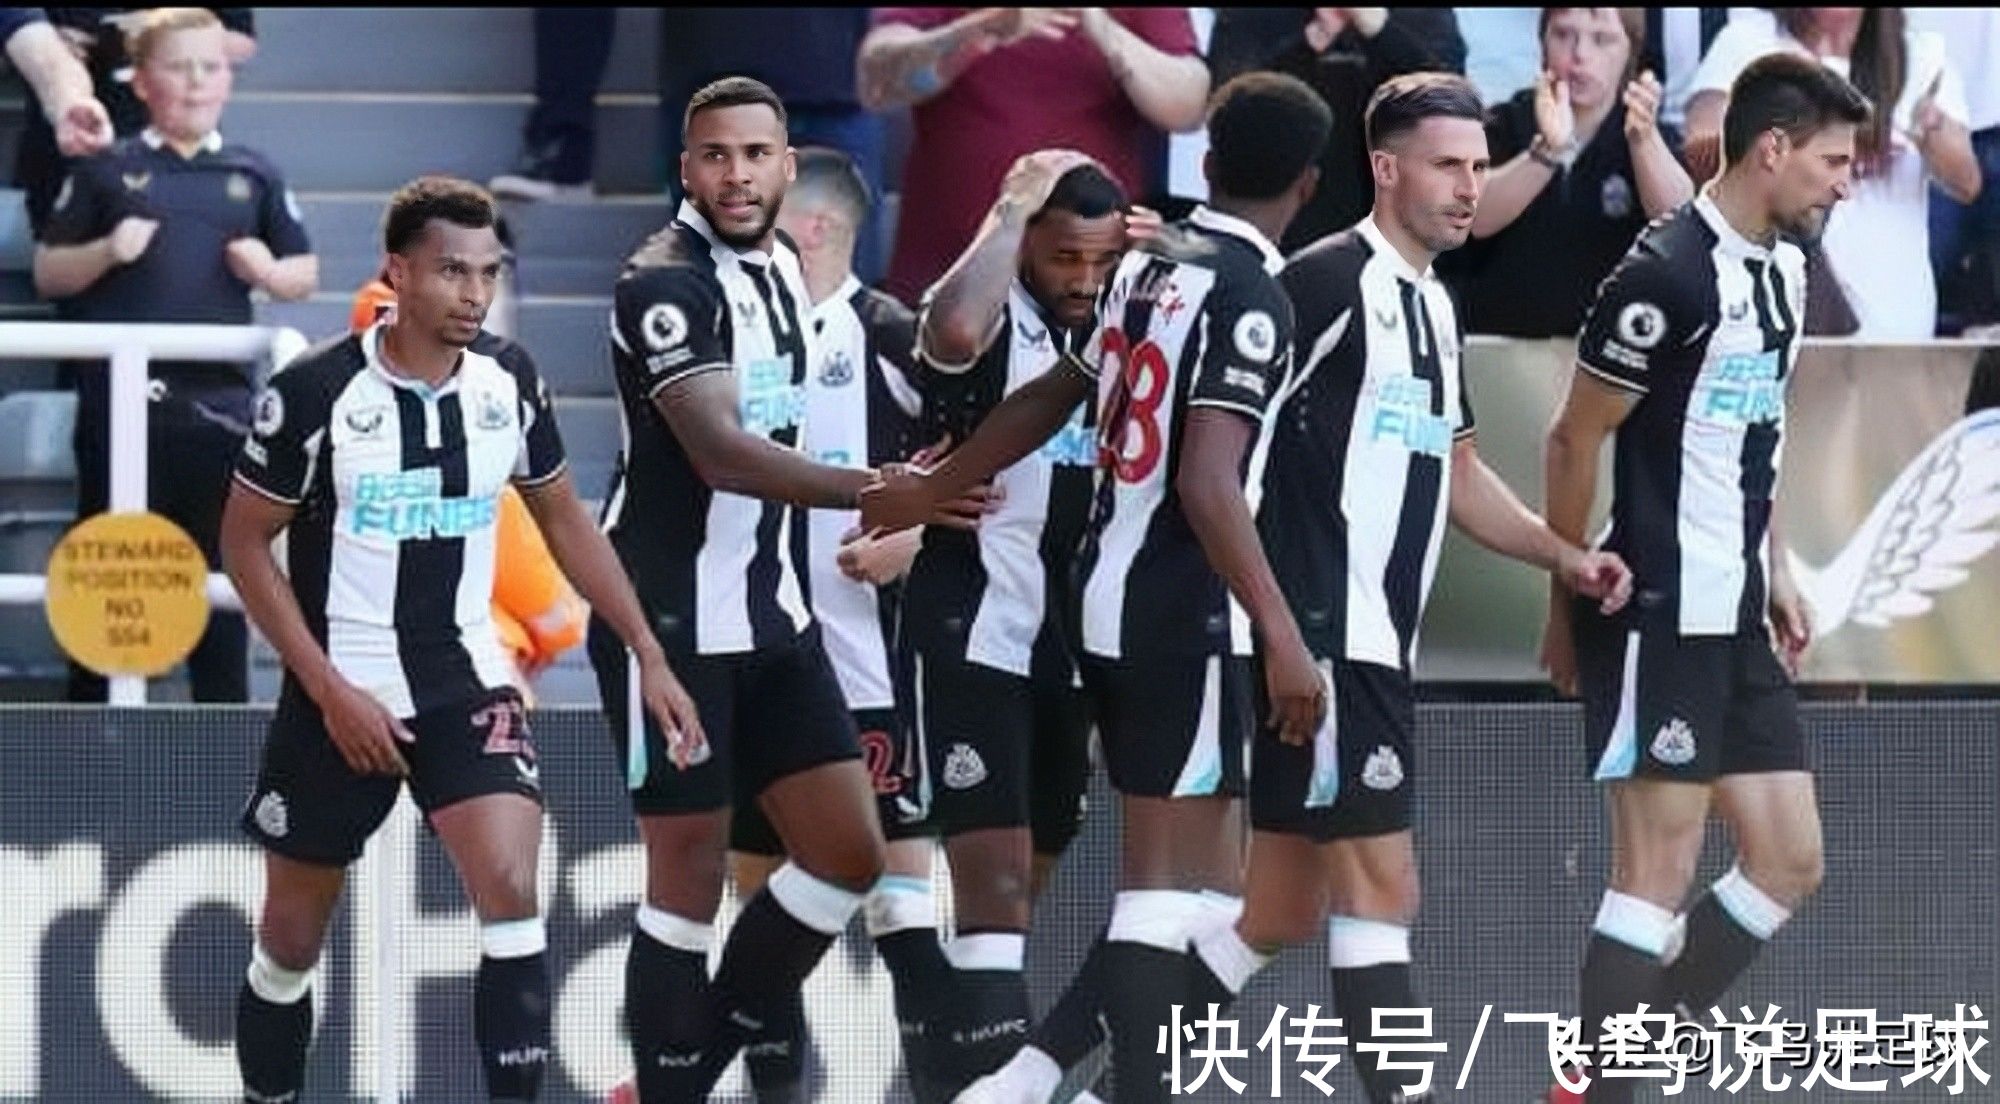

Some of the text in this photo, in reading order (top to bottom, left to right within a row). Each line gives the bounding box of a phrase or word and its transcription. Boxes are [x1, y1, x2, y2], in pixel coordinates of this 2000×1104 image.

[62, 539, 194, 562] STEWARD
[65, 569, 193, 591] POSITION
[104, 598, 145, 618] NO
